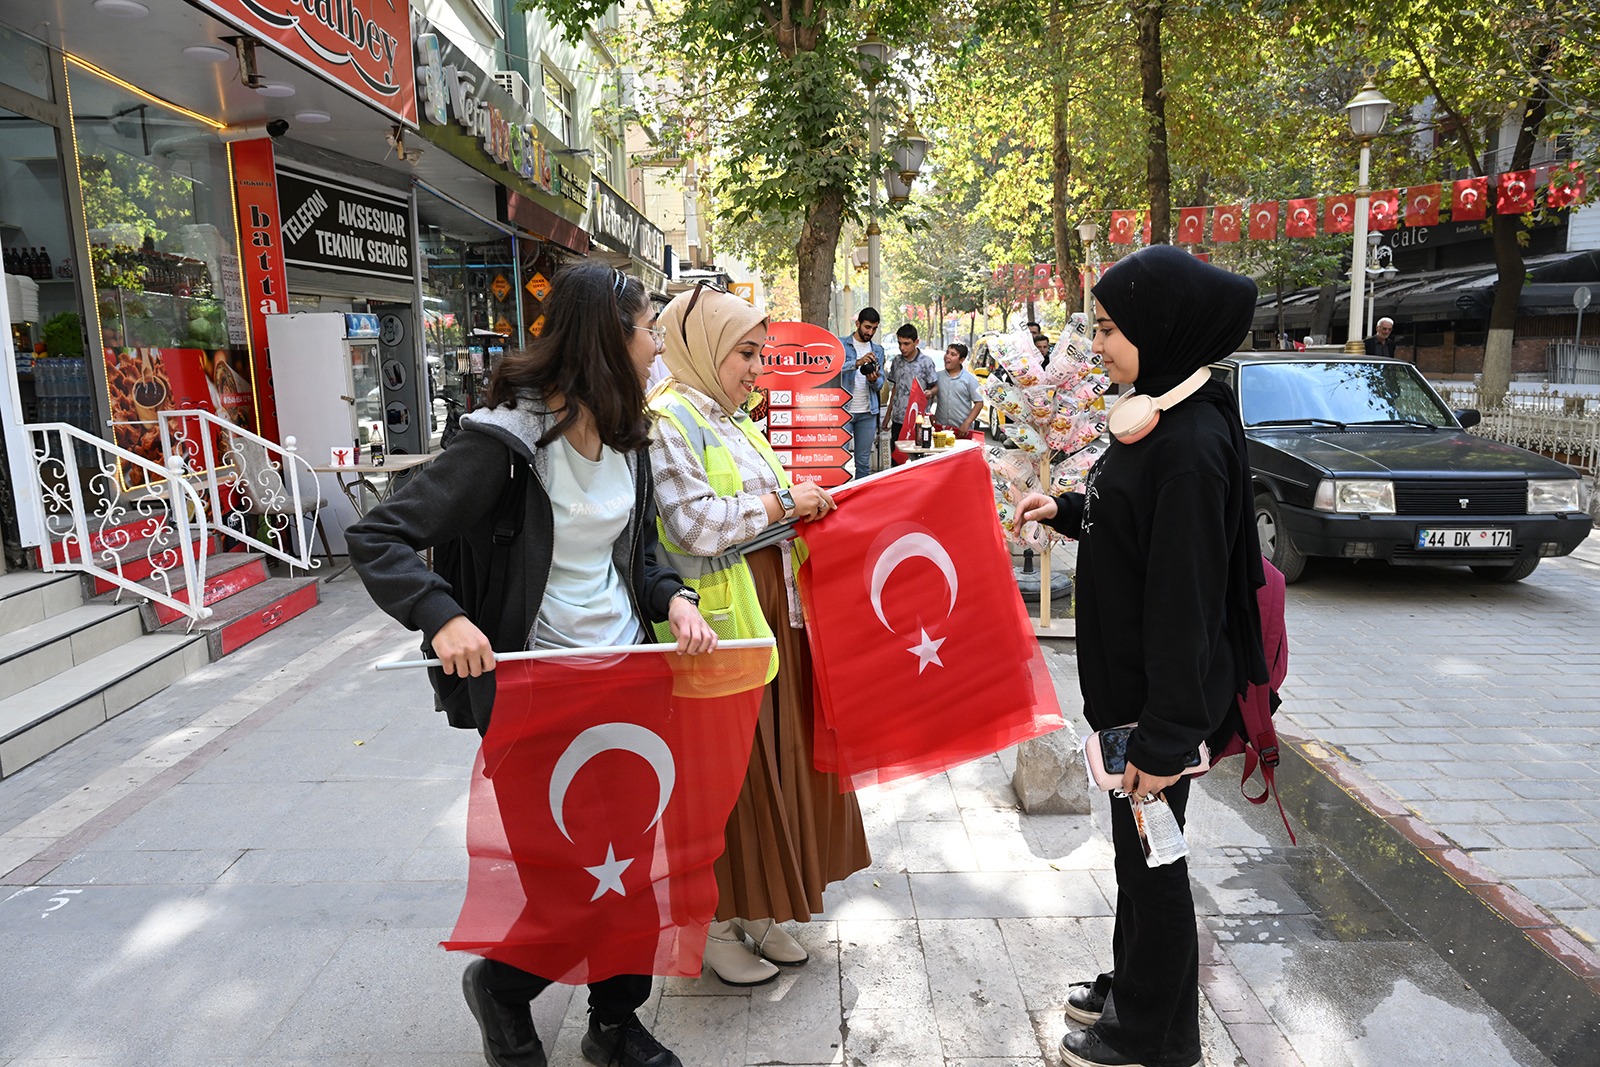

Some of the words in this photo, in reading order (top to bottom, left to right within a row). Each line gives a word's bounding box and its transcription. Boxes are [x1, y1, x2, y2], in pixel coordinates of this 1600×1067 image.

[281, 189, 328, 245] TELEFON
[338, 200, 406, 238] AKSESUAR
[315, 229, 365, 261] TEKNİK
[366, 239, 408, 268] SERVİS
[772, 392, 790, 404] 20
[819, 393, 840, 402] Dürüm
[772, 413, 789, 423] 25
[795, 414, 817, 422] Normal
[818, 412, 839, 422] Dürüm
[772, 433, 788, 444] 30
[795, 434, 817, 442] Double
[817, 432, 838, 442] Dürüm
[795, 454, 813, 463] Mega
[813, 452, 834, 462] Dürüm
[1428, 532, 1446, 547] 44
[1454, 532, 1472, 547] DK
[1491, 531, 1511, 547] 171
